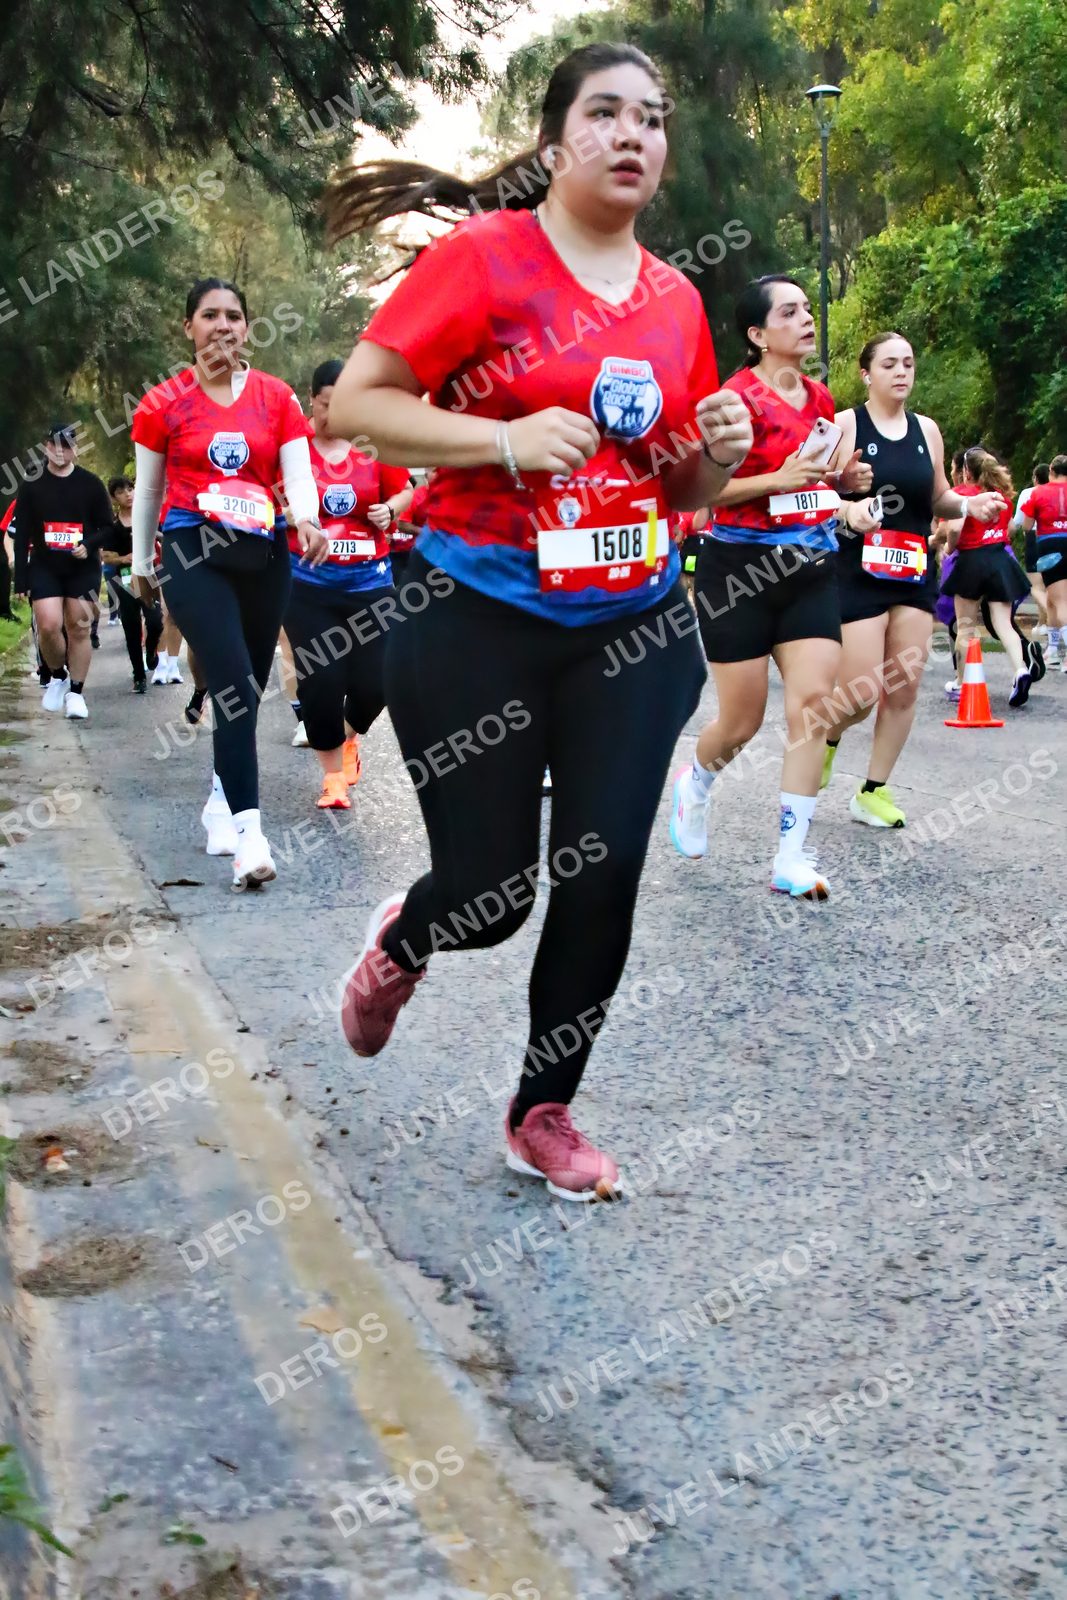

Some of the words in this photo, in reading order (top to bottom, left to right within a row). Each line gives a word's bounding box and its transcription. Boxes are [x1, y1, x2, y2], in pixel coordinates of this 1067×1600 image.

[611, 379, 647, 397] Global
[602, 391, 632, 408] Race
[223, 497, 256, 516] 3200
[794, 492, 818, 510] 1817
[53, 533, 71, 542] 3273
[592, 527, 641, 562] 1508
[333, 541, 356, 553] 2713
[884, 549, 909, 565] 1705
